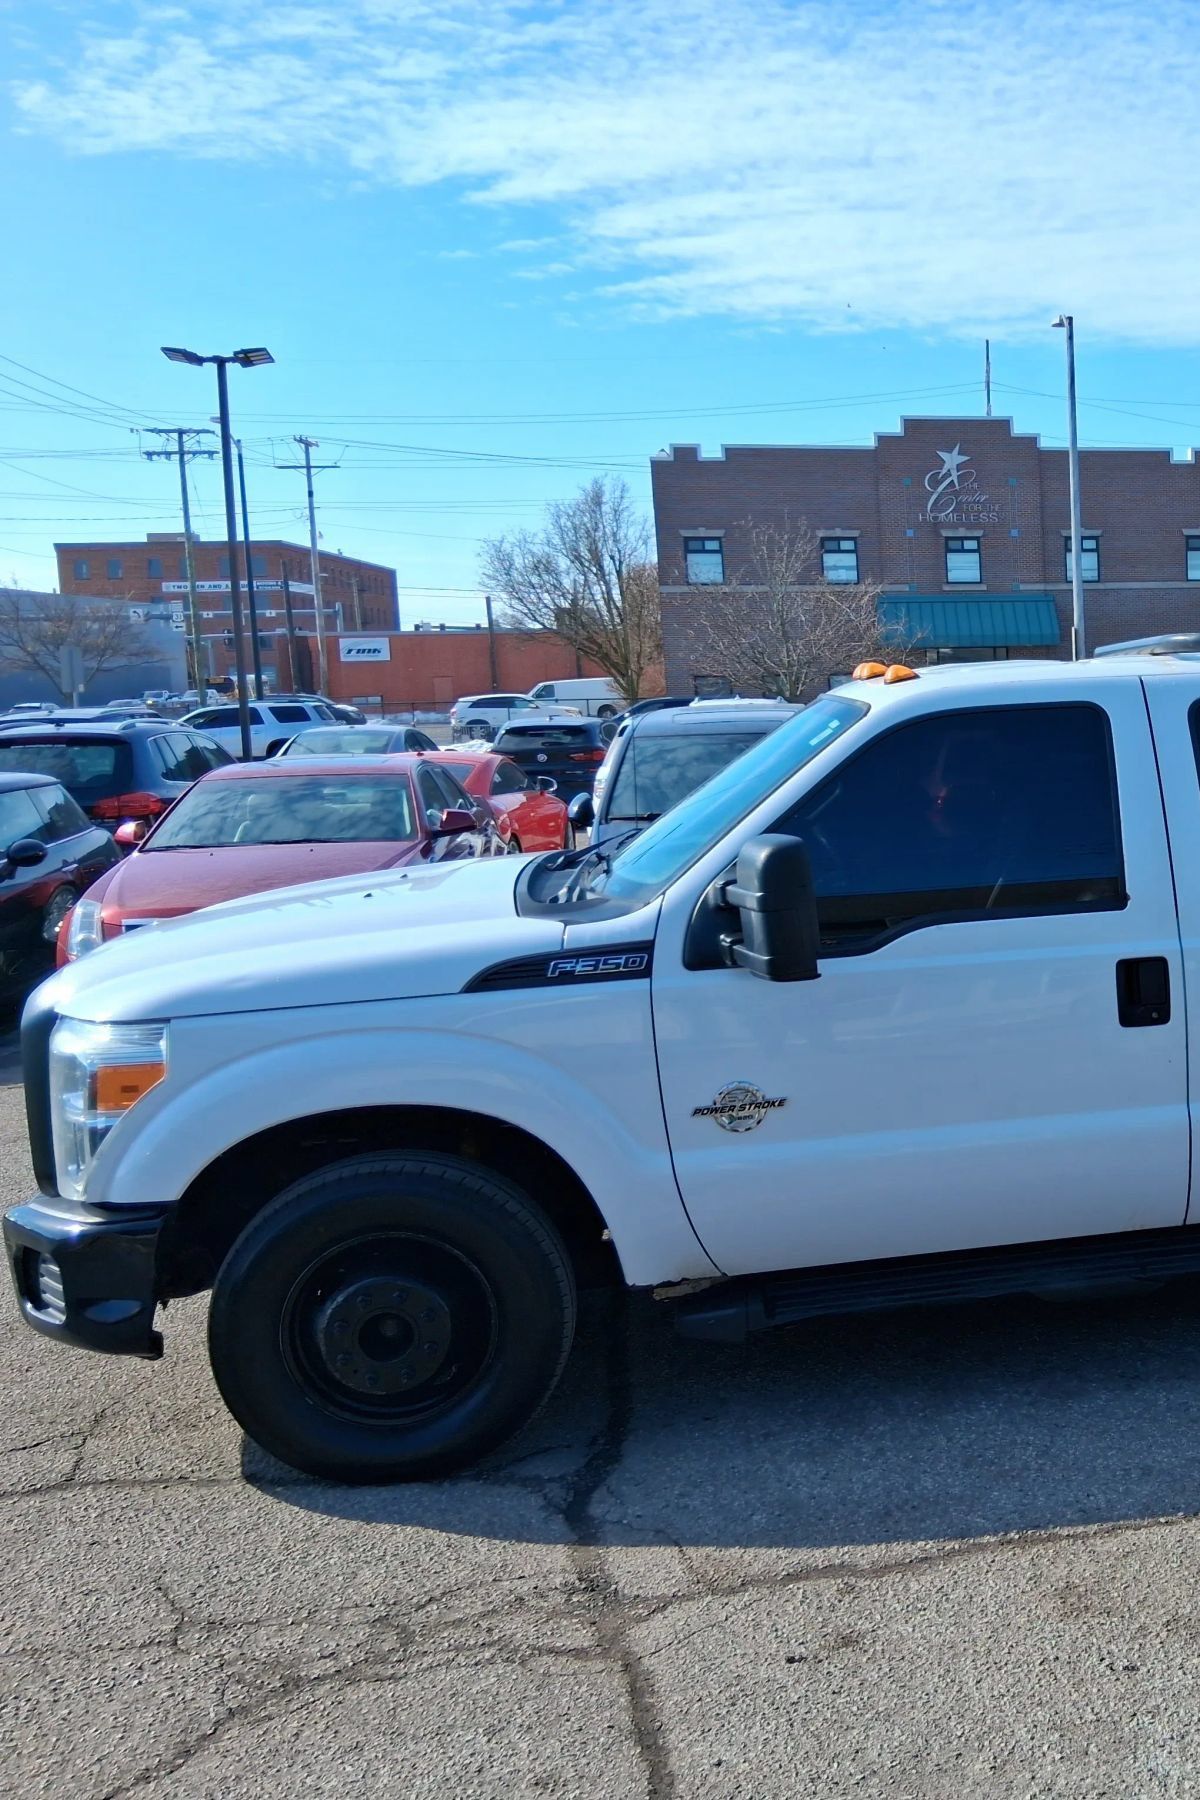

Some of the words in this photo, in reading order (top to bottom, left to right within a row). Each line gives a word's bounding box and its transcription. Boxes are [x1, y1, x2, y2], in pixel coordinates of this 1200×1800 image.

[965, 482, 980, 491] THE
[963, 503, 982, 512] FOR
[986, 503, 1002, 512] THE
[919, 512, 999, 522] HOMELESS
[692, 1105, 736, 1117] POWER
[738, 1098, 787, 1112] STROKE
